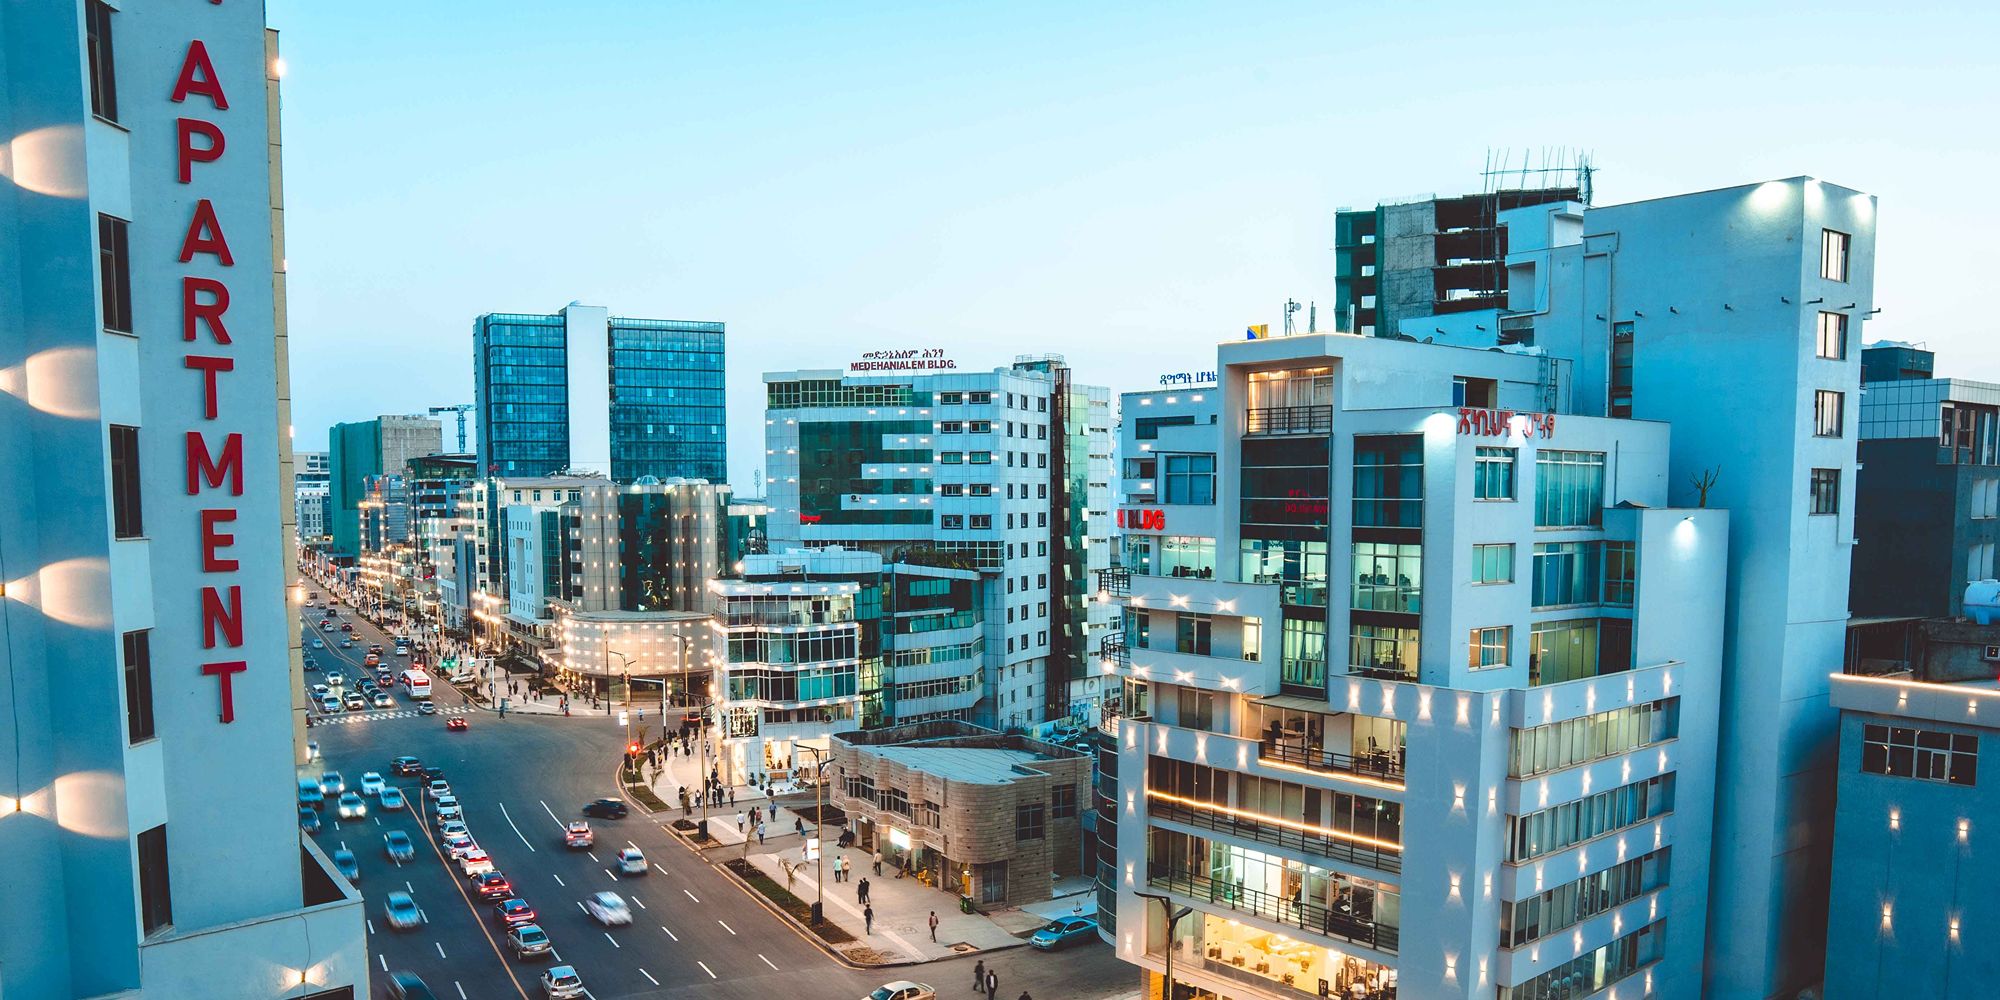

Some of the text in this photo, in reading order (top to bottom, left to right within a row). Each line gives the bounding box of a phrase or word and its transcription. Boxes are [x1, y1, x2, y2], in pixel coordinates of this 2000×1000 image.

[850, 360, 957, 371] MEDEHANIALEM BLDG.
[171, 39, 247, 724] APARTMENT
[1127, 509, 1165, 531] BLDG
